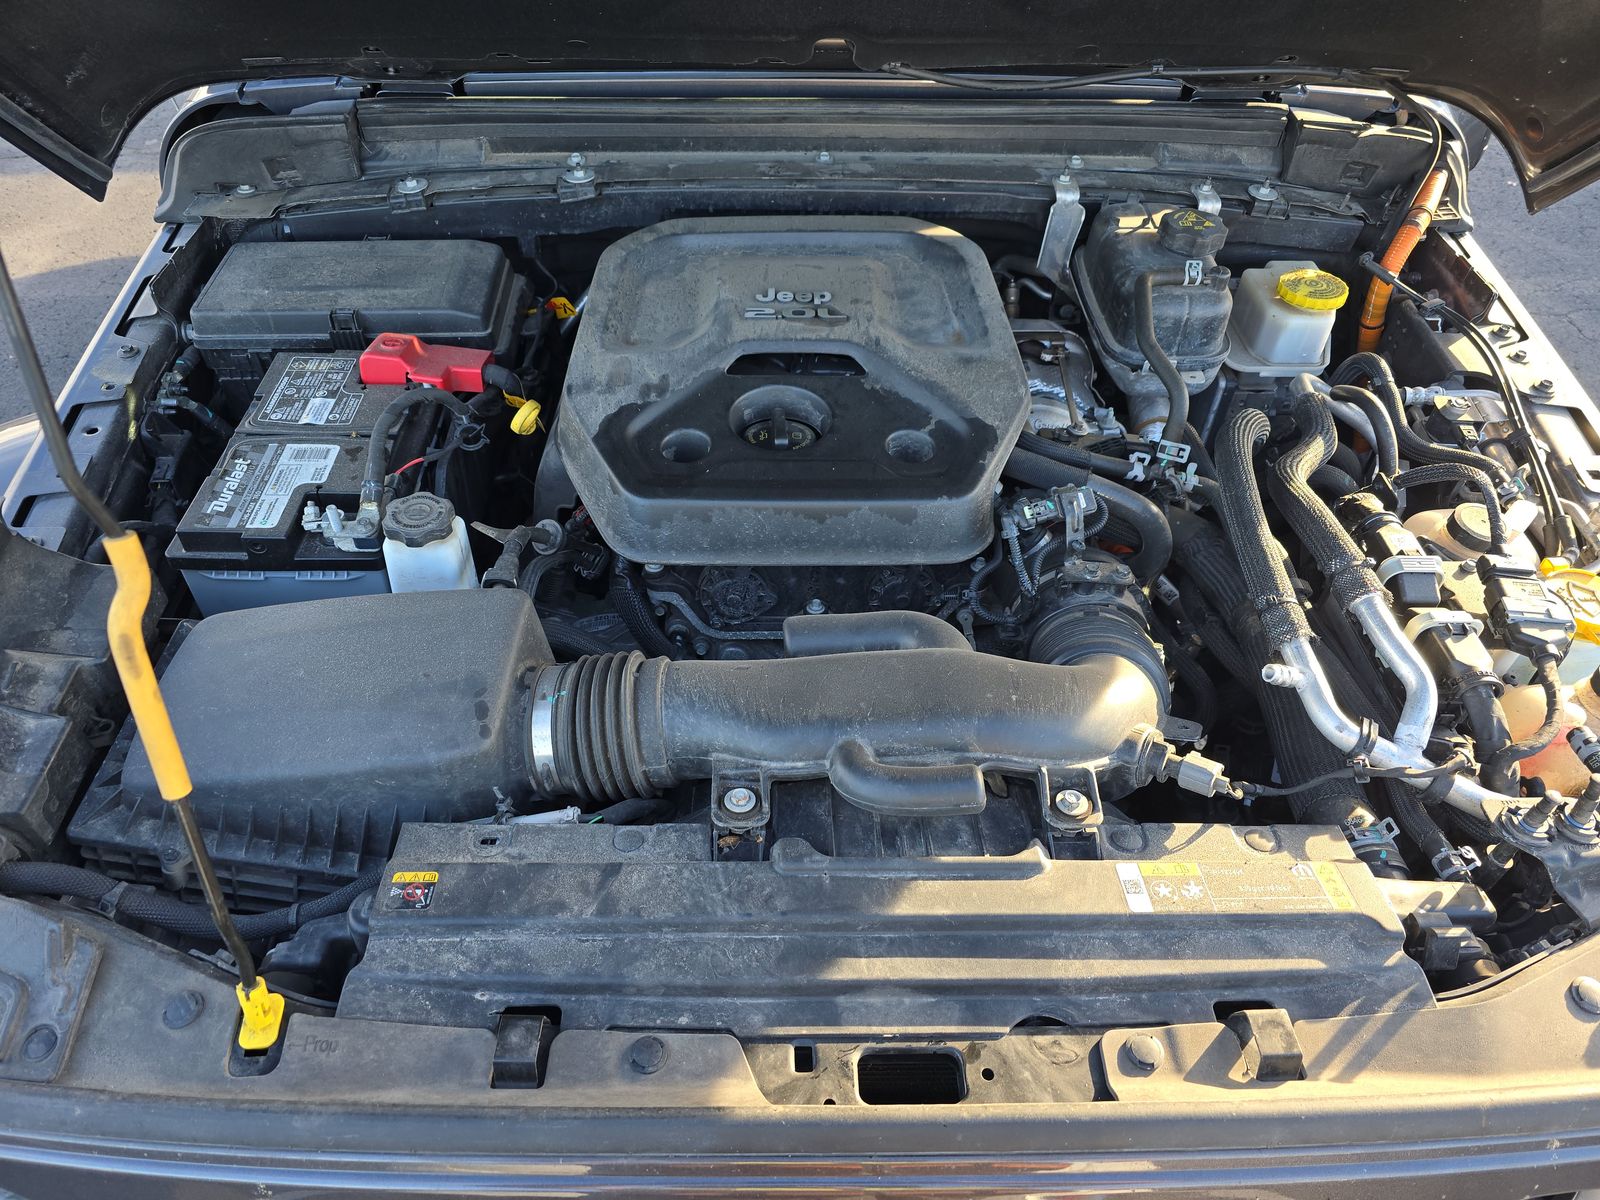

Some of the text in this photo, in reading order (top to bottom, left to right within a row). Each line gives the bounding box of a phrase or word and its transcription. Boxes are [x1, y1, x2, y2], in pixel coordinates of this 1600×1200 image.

[755, 287, 832, 305] Jeep
[743, 307, 849, 319] 2.0L
[206, 458, 252, 513] Duralast
